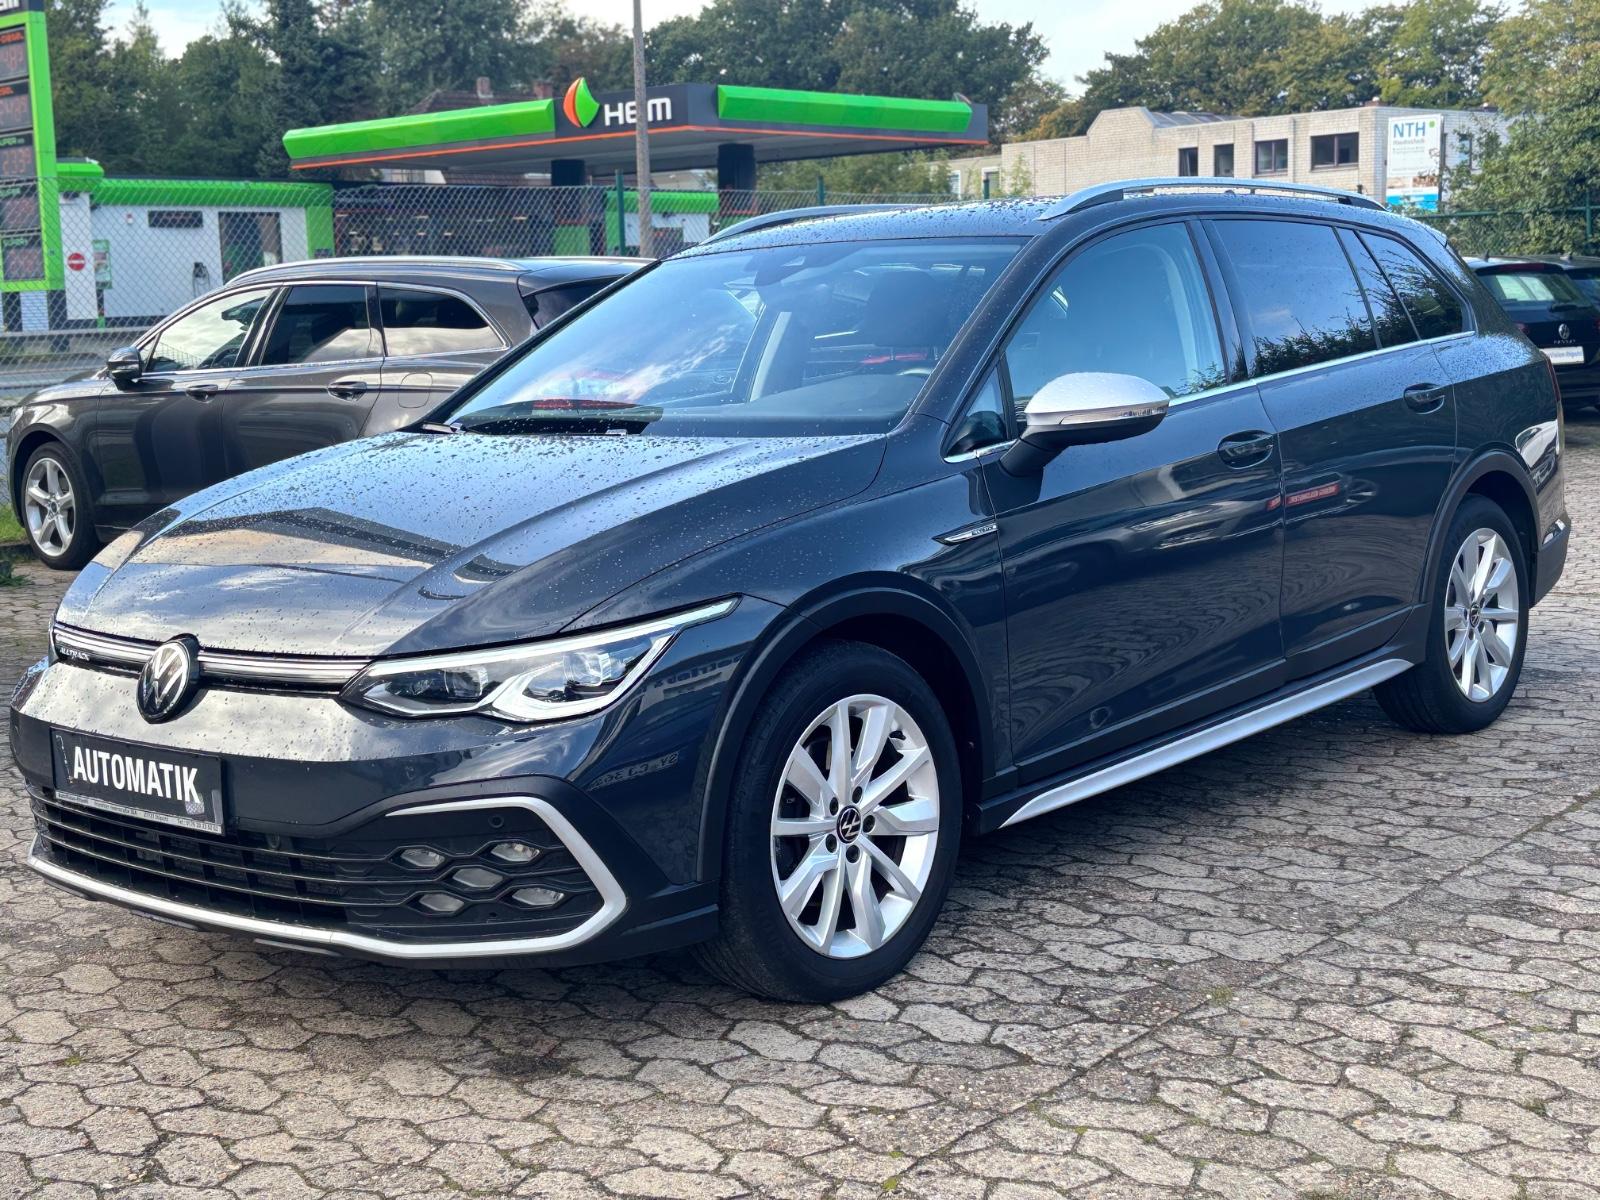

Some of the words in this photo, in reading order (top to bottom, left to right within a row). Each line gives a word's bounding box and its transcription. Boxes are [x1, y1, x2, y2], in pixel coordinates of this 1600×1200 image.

[604, 97, 672, 127] HEM
[1393, 121, 1426, 138] NTH
[74, 746, 200, 803] AUTOMATIK
